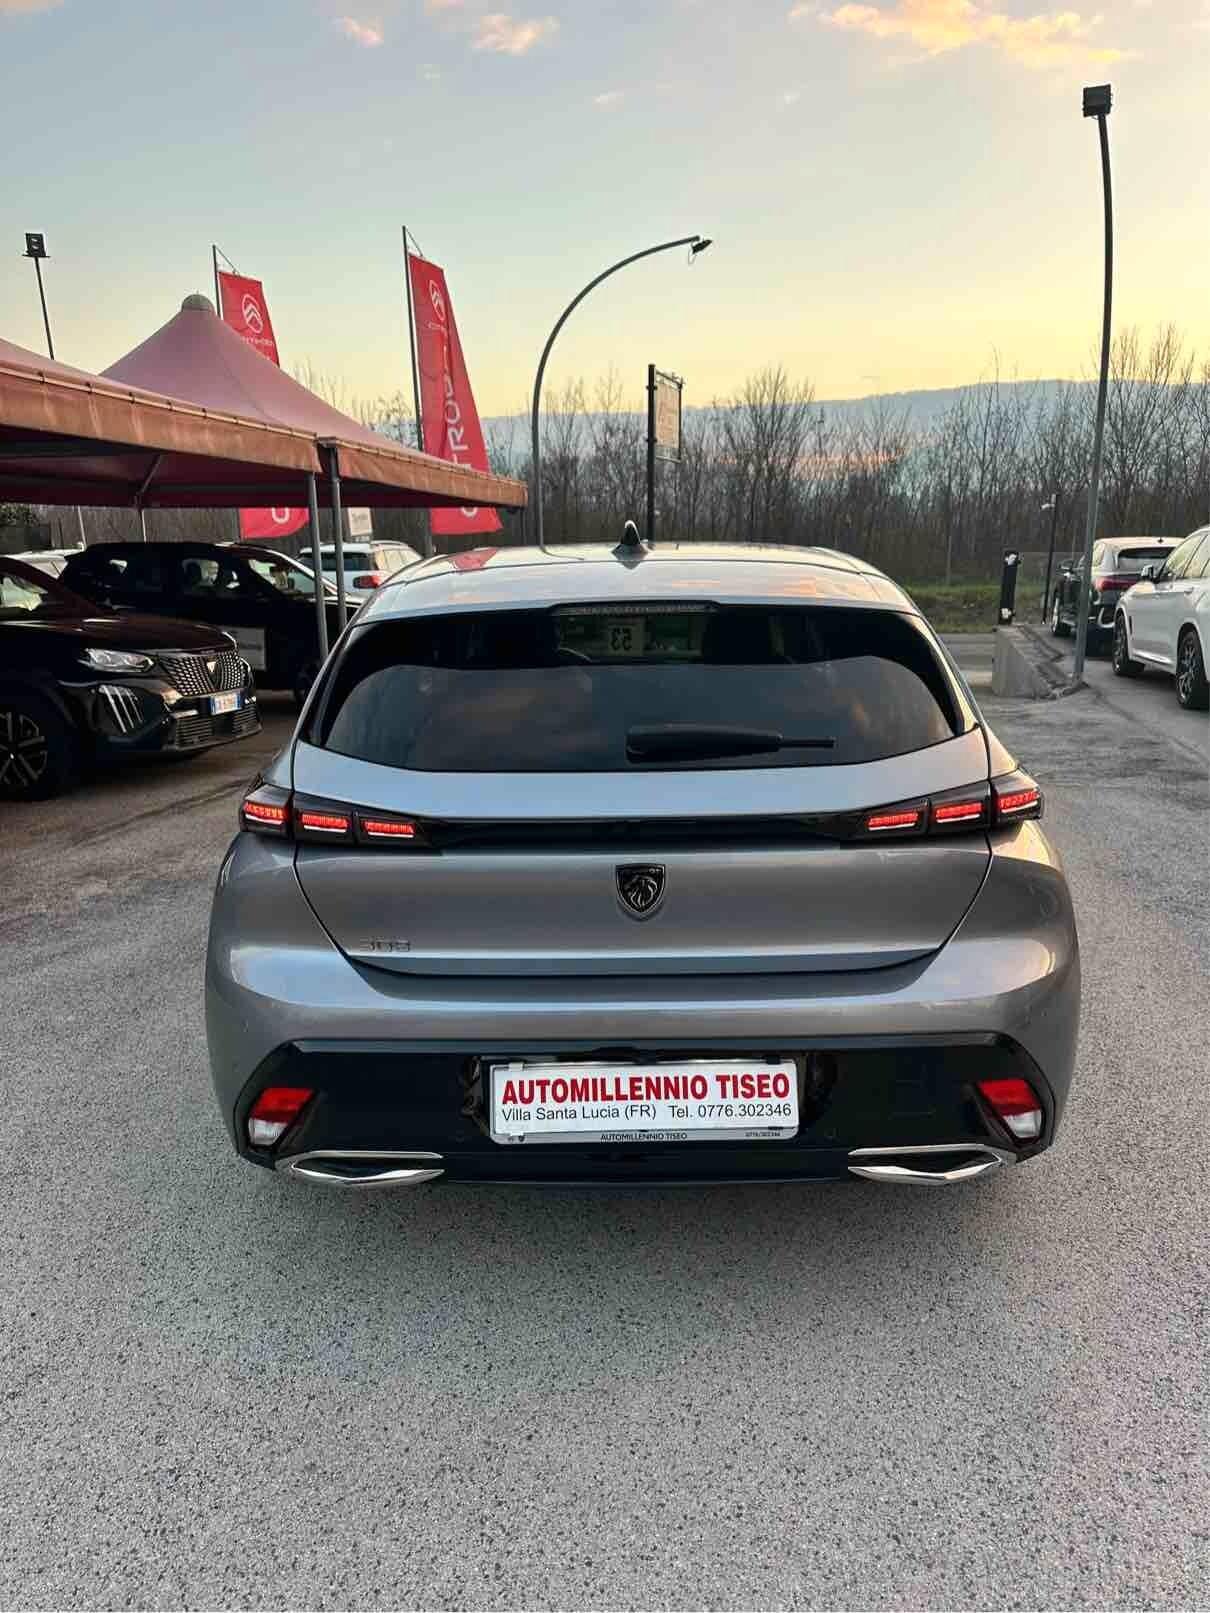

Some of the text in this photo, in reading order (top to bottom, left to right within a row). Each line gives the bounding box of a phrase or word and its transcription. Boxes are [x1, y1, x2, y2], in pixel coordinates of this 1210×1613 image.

[502, 1073, 790, 1105] AUTOMILLENNIO TISEO
[502, 1103, 792, 1122] Villa Santa Lucia (FR) Tel. 0776.302346
[600, 1133, 664, 1142] AUTOMILLENNIO
[665, 1132, 688, 1141] TISEO
